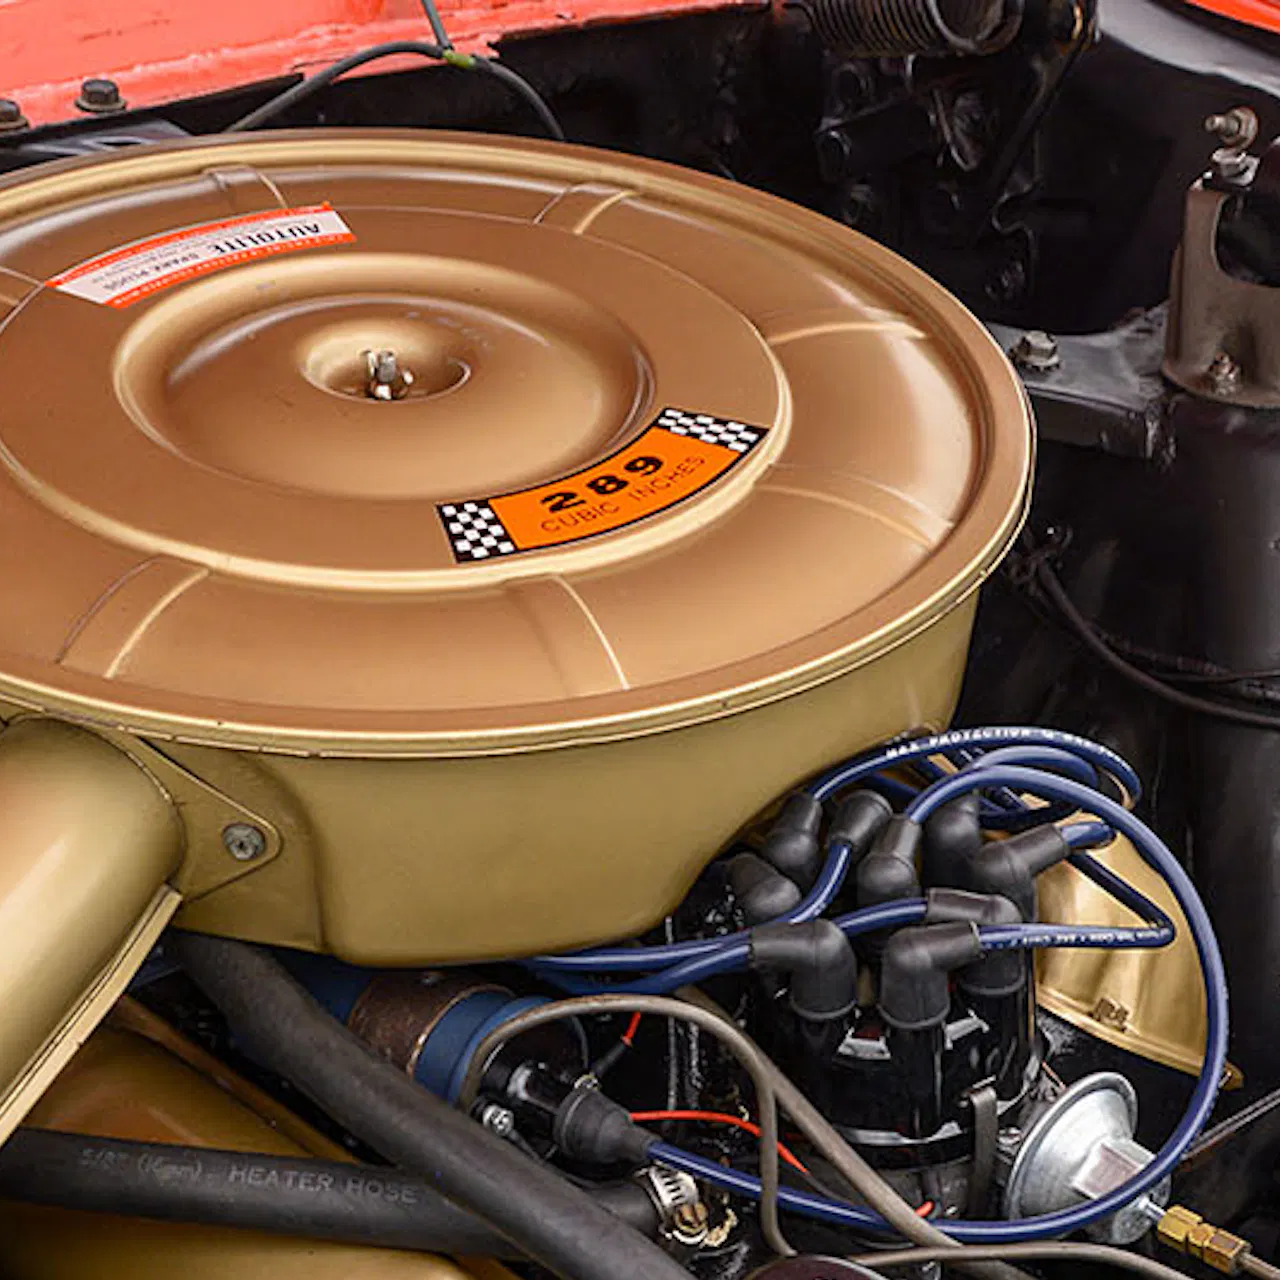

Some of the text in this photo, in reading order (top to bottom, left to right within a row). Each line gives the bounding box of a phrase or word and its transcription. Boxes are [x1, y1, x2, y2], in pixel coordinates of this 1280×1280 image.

[208, 223, 320, 253] AUTOLITE
[539, 456, 664, 513] 289
[540, 456, 705, 532] CUBIC INCHES
[227, 1163, 335, 1193] HEATER
[346, 1177, 419, 1205] HOSE
